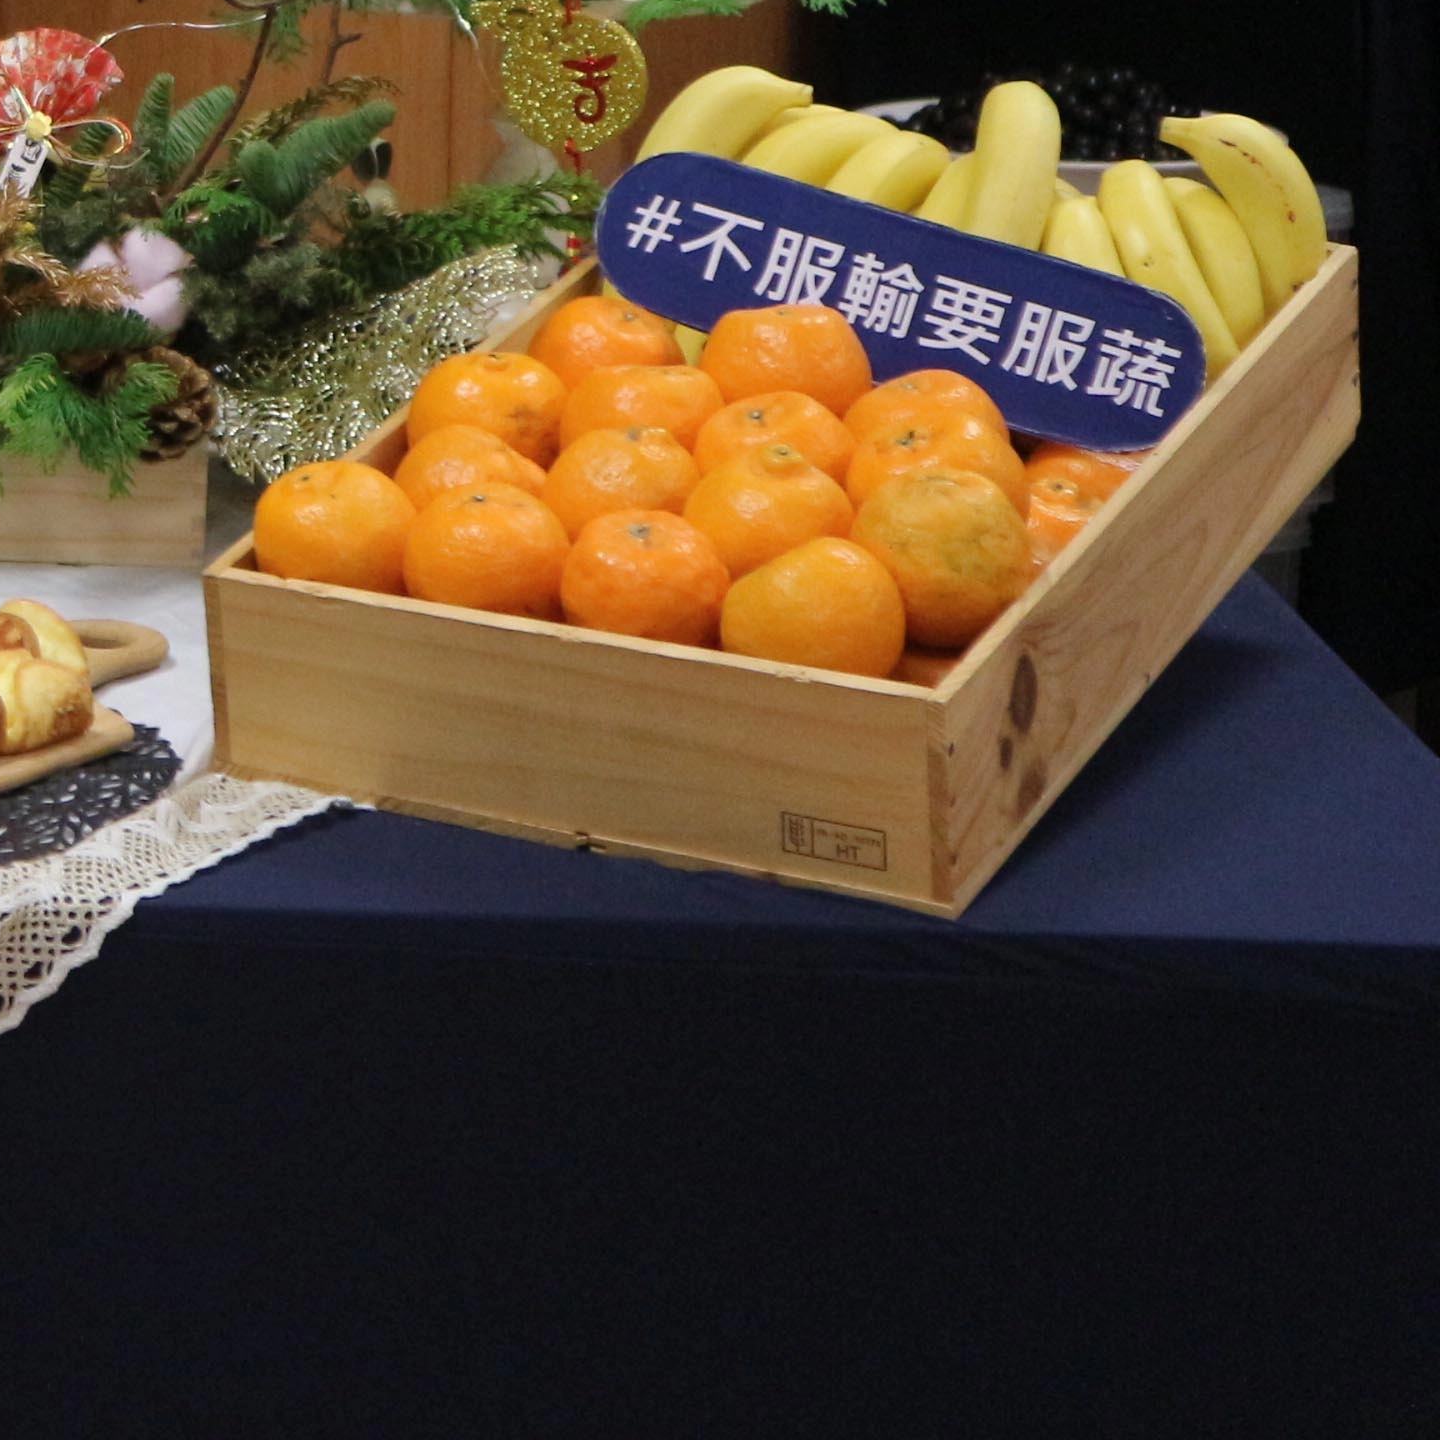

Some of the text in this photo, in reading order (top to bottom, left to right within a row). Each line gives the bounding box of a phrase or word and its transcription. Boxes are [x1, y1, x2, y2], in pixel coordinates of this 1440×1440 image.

[626, 194, 1183, 418] #不服輸要服蔬
